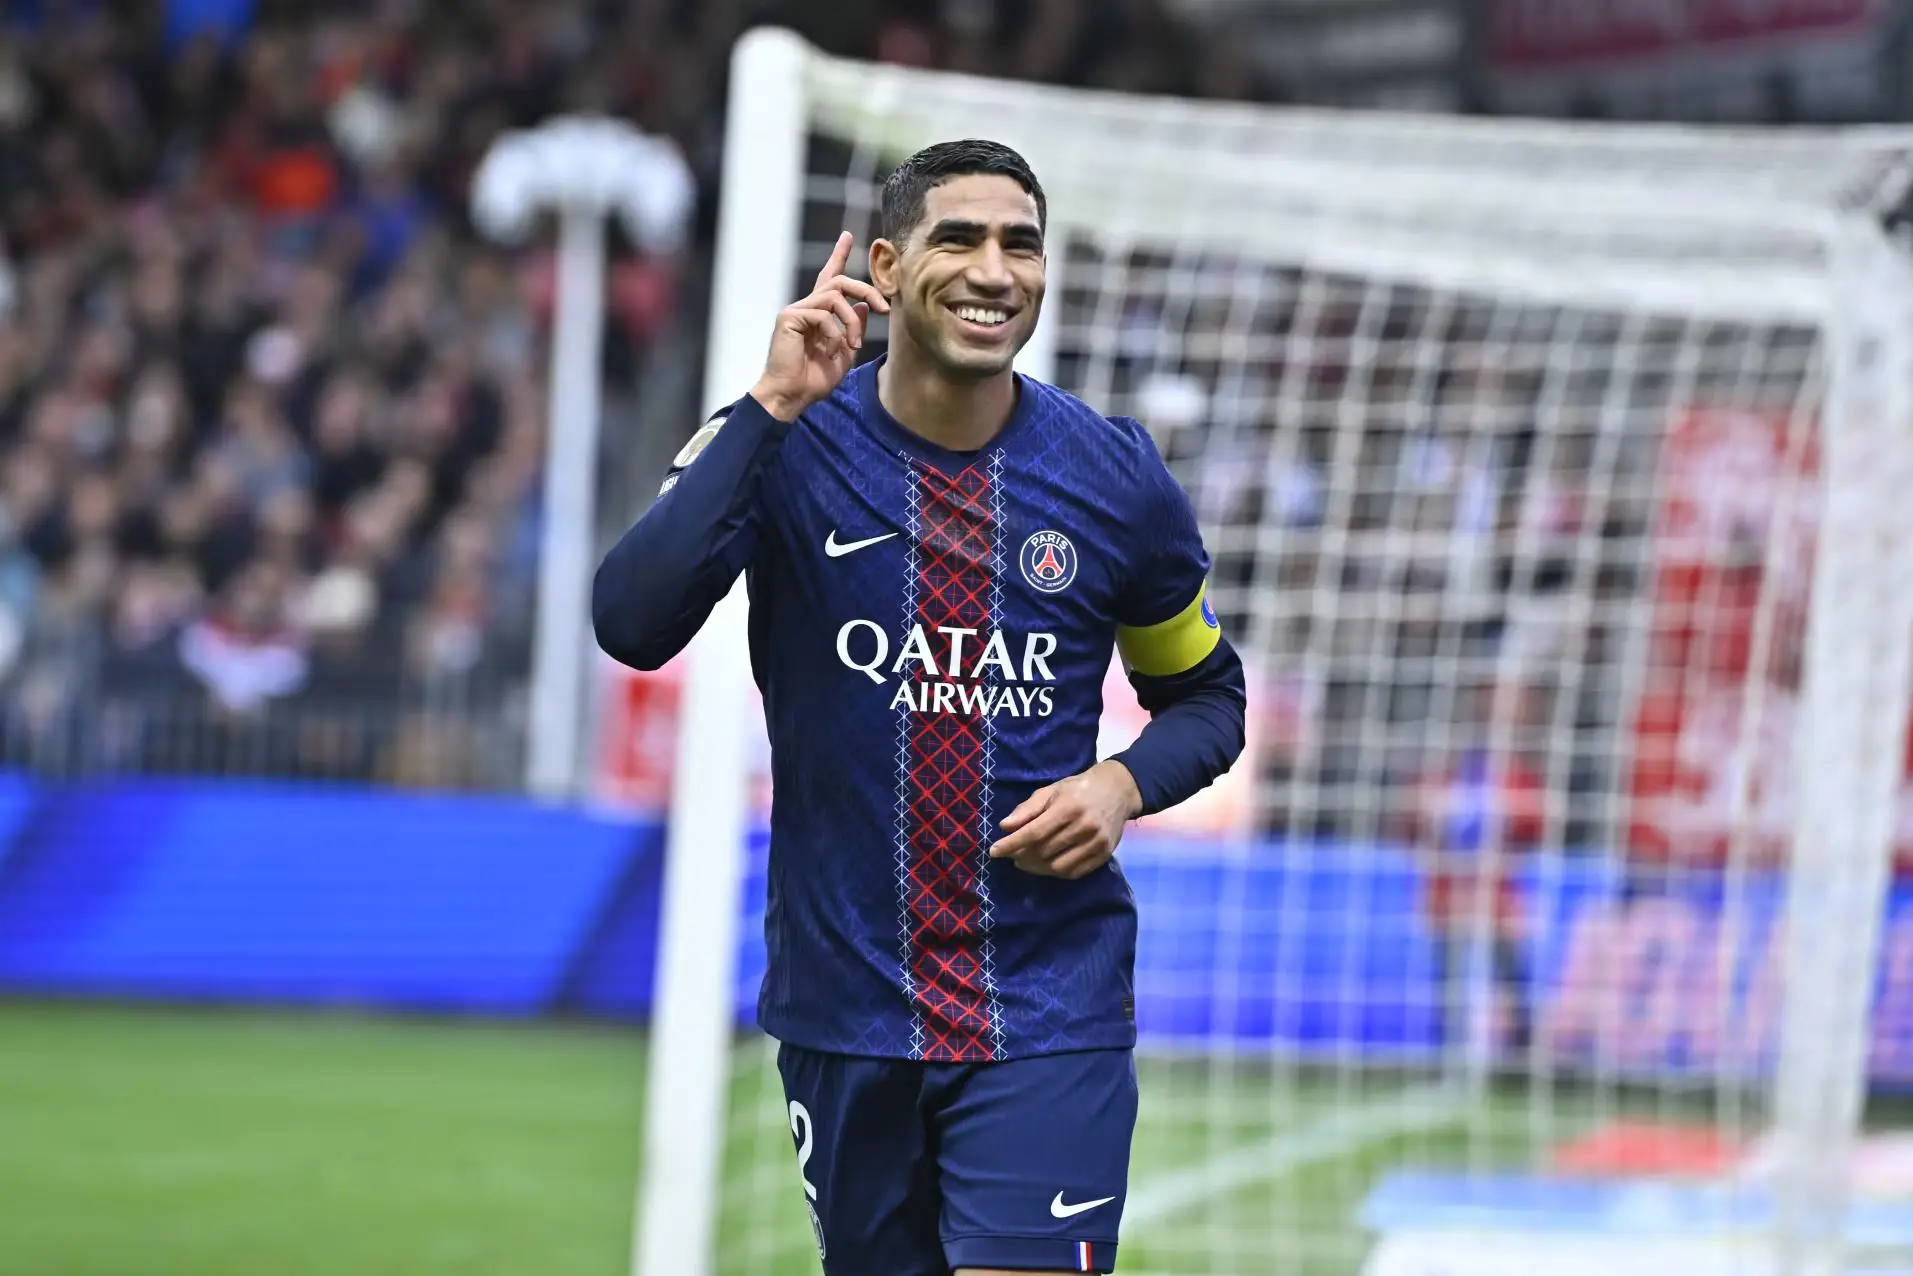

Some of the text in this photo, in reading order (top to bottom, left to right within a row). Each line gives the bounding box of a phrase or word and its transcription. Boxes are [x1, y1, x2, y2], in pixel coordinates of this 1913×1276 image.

[1030, 533, 1068, 550] PARIS
[836, 619, 1057, 685] QATAR
[889, 680, 1055, 717] AIRWAYS
[789, 1100, 817, 1201] 2
